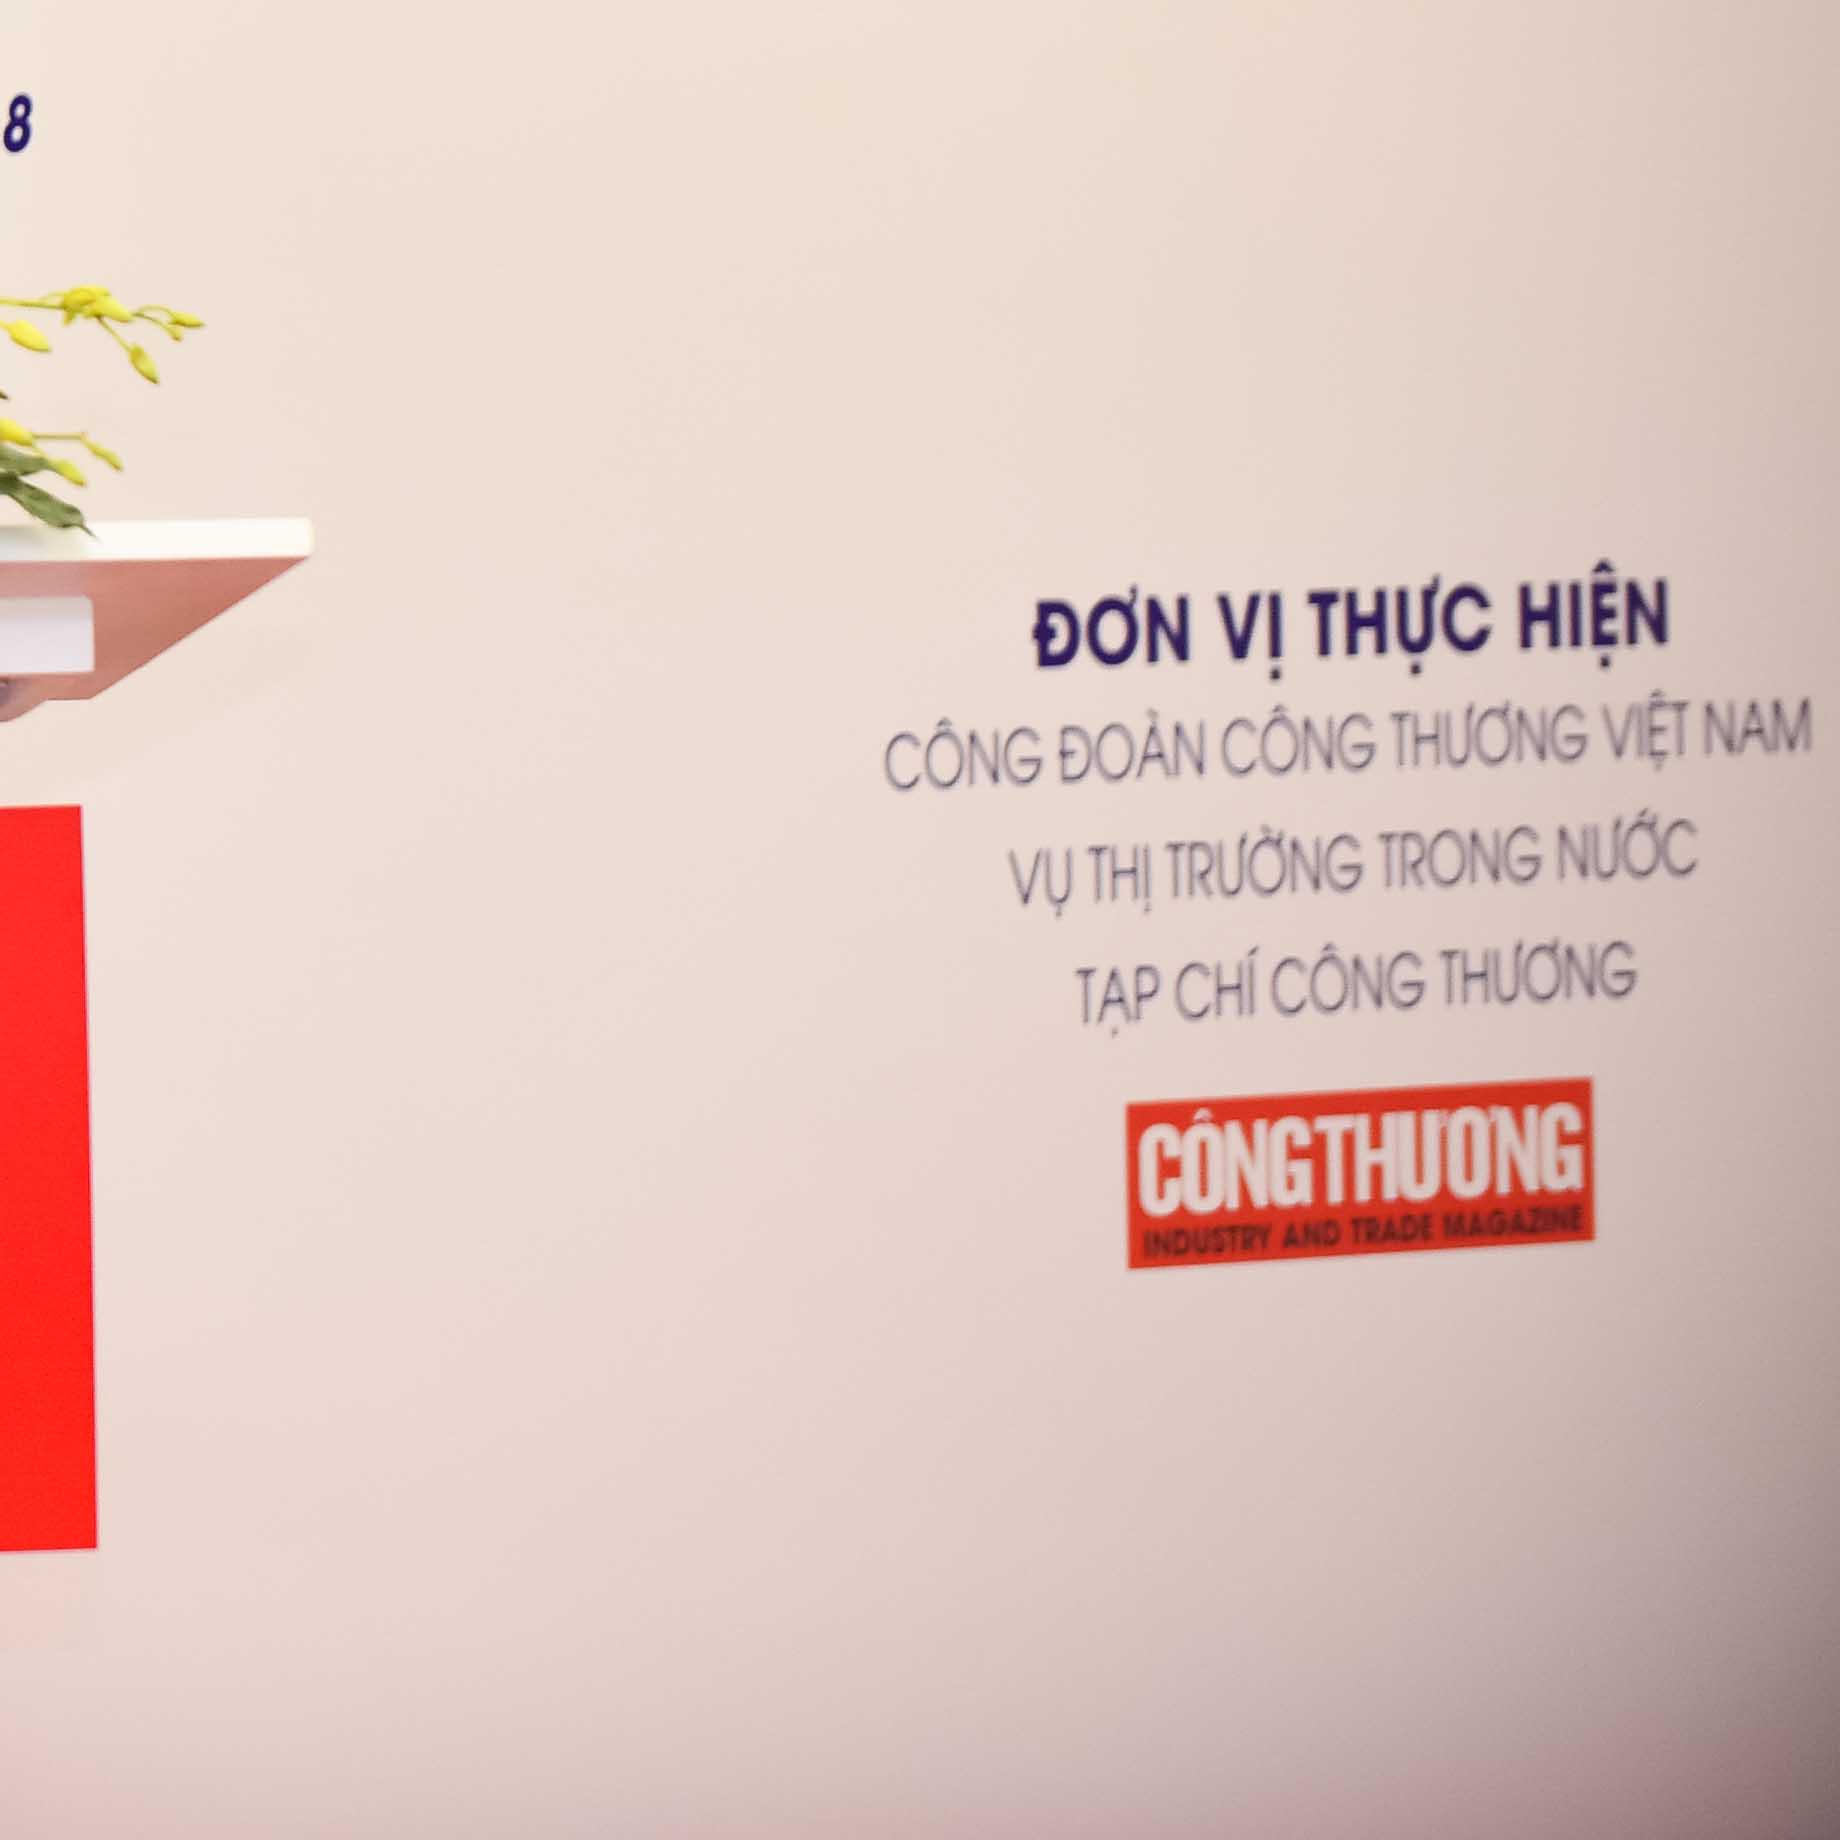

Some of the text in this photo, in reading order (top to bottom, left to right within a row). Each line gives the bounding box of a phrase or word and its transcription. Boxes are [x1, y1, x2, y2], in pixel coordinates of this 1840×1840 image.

[1032, 560, 1668, 680] ĐƠN VỊ THỰC HIỆN
[885, 718, 1043, 792] CÔNG
[1221, 704, 1376, 778] CÔNG
[1390, 701, 1588, 768] THƯƠNG
[1602, 689, 1690, 771] VIỆT
[1704, 697, 1811, 755] NAM
[1008, 808, 1697, 916] VỤ THỊ TRƯỜNG TRONG NƯỚC
[1075, 939, 1638, 1037] TẠP CHÍ CÔNG THƯƠNG
[1143, 1204, 1583, 1258] INDUSTRY AND TRADE MAGAZINE
